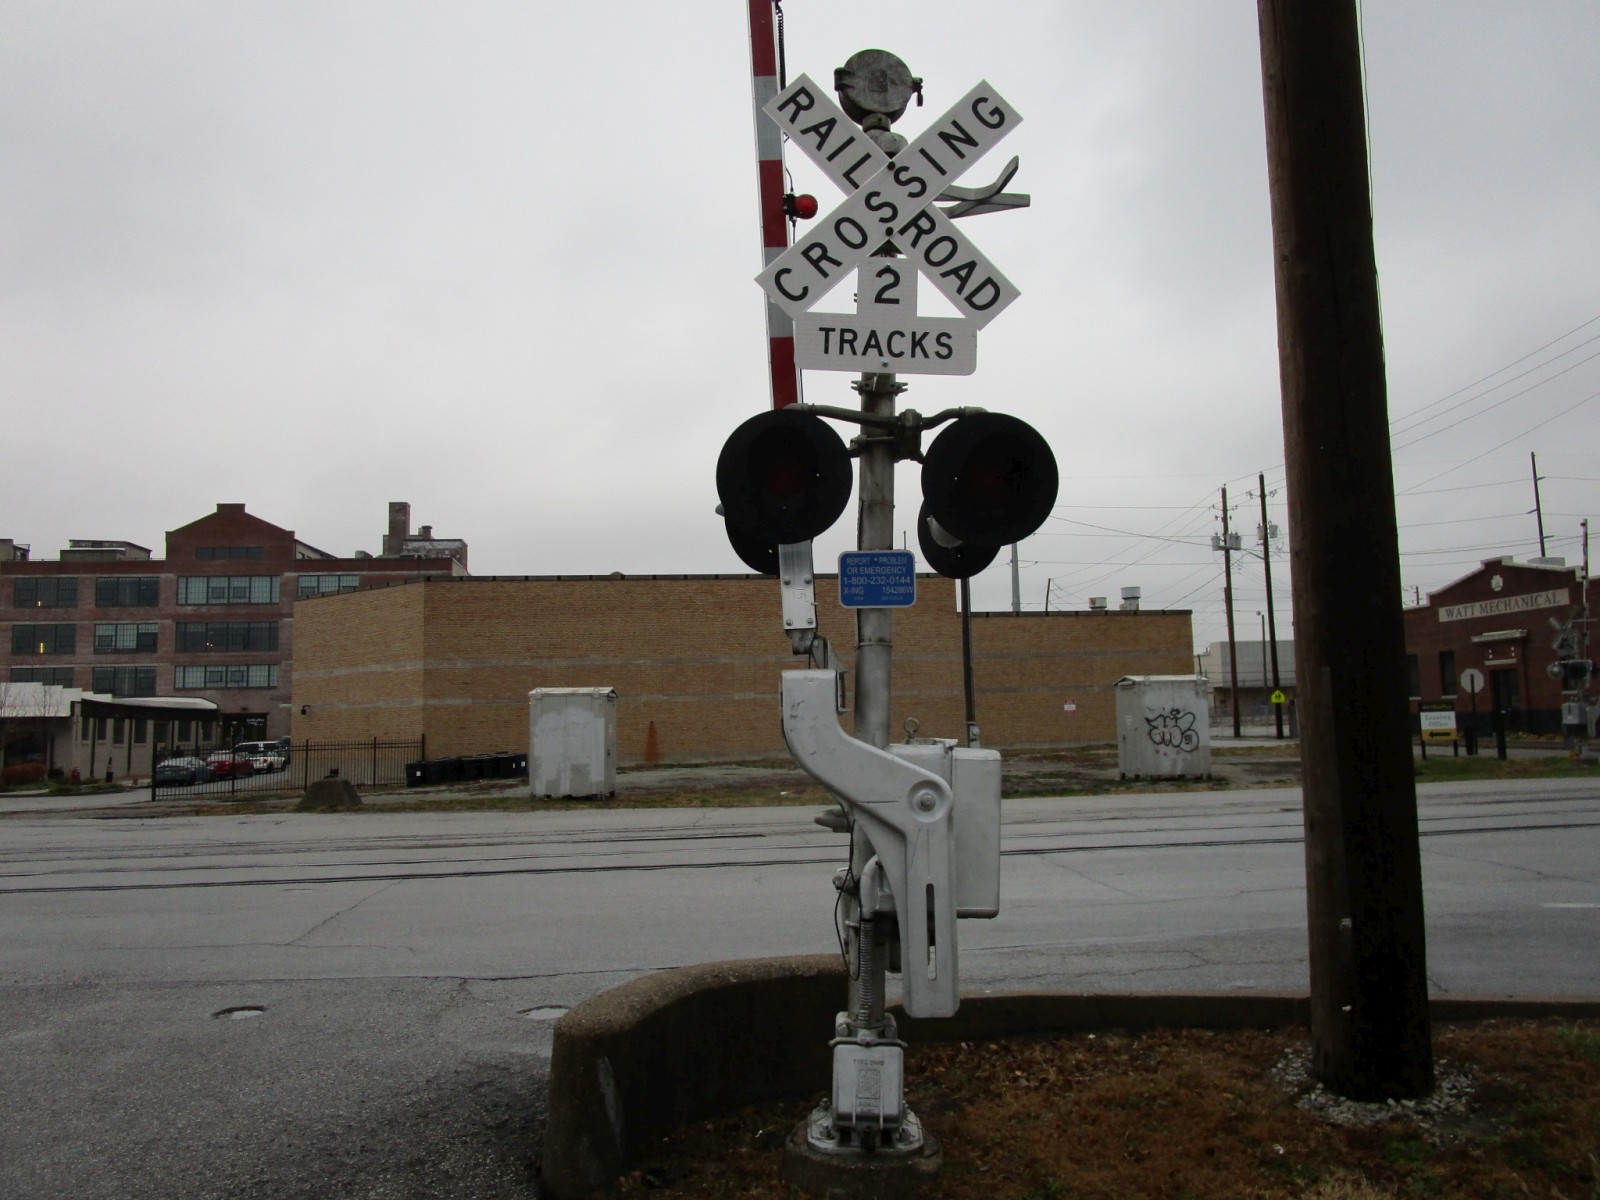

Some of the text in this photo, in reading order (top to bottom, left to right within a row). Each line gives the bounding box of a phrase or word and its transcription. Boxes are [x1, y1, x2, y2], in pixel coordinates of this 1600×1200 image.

[777, 86, 872, 190] RAIL
[774, 96, 1006, 302] CROSSING
[897, 210, 1001, 311] ROAD
[874, 269, 901, 305] 2
[818, 326, 953, 360] TRACKS
[847, 557, 870, 565] REPORT
[879, 557, 907, 565] PROBLEM
[847, 567, 907, 575] OR EMERGENCY
[843, 575, 911, 585] 1-800-232-0144
[1445, 591, 1561, 619] WATT MECHANICAL
